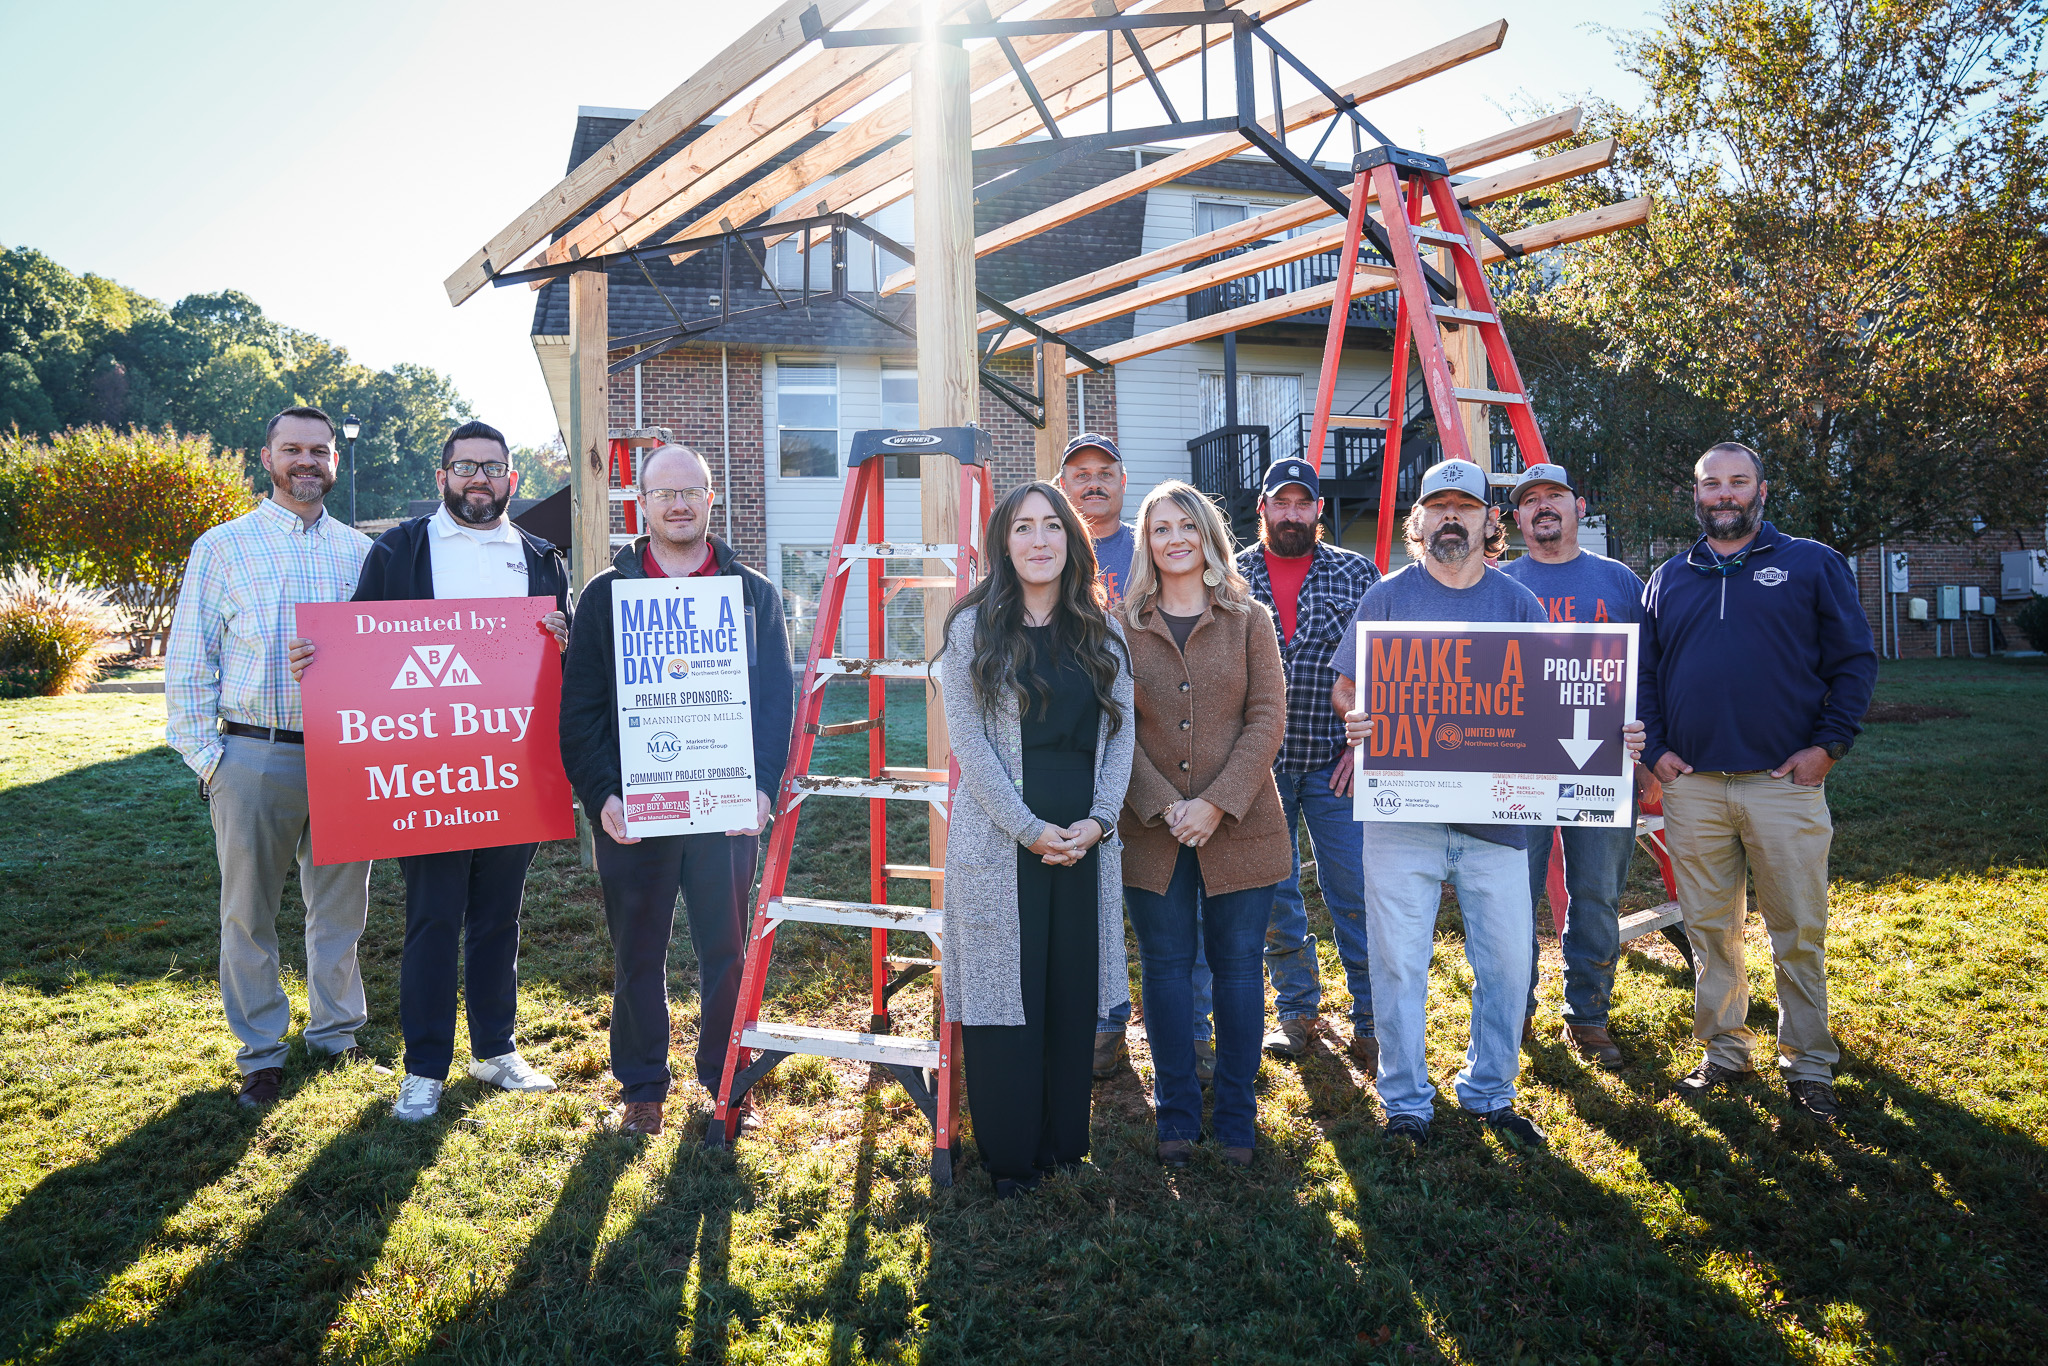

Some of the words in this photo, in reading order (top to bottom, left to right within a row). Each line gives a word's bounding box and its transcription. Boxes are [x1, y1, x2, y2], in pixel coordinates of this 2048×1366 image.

[621, 597, 696, 632] MAKE
[718, 596, 735, 628] A
[1537, 596, 1576, 622] KE
[1594, 598, 1608, 622] A
[355, 612, 462, 634] Donated
[470, 611, 507, 634] by:
[622, 628, 738, 656] DIFFERENCE
[429, 650, 440, 664] B
[690, 660, 716, 669] UNITED
[716, 659, 732, 667] WAY
[1372, 638, 1472, 683] MAKE
[1501, 640, 1524, 684] A
[406, 672, 418, 686] B
[452, 669, 468, 684] M
[624, 656, 665, 685] DAY
[720, 669, 741, 677] Georgia
[1544, 658, 1624, 682] PROJECT
[636, 692, 677, 706] PREMIER
[680, 690, 732, 704] SPONSORS:
[1372, 682, 1525, 716] DIFFERENCE
[1560, 682, 1606, 706] HERE
[336, 707, 438, 744] Best
[449, 702, 535, 742] Buy
[642, 714, 711, 726] MANNINGTON
[714, 712, 744, 721] MILLS.
[1370, 714, 1437, 758] DAY
[1464, 728, 1495, 738] UNITED
[1497, 728, 1516, 738] WAY
[647, 740, 682, 753] MAG
[1500, 741, 1526, 749] Georgia
[365, 755, 520, 800] Metals
[630, 771, 673, 784] COMMUNITY
[676, 769, 705, 780] PROJECT
[708, 766, 747, 778] SPONSORS:
[1380, 780, 1436, 788] MANNINGTON
[1576, 784, 1615, 797] Dalton
[627, 803, 645, 815] BEST
[646, 802, 660, 810] BUY
[662, 800, 690, 811] METALS
[1373, 797, 1402, 808] MAG
[392, 811, 417, 831] of
[424, 807, 500, 828] Dalton
[1492, 811, 1542, 820] MOHAWK
[1579, 810, 1614, 822] Shaw
